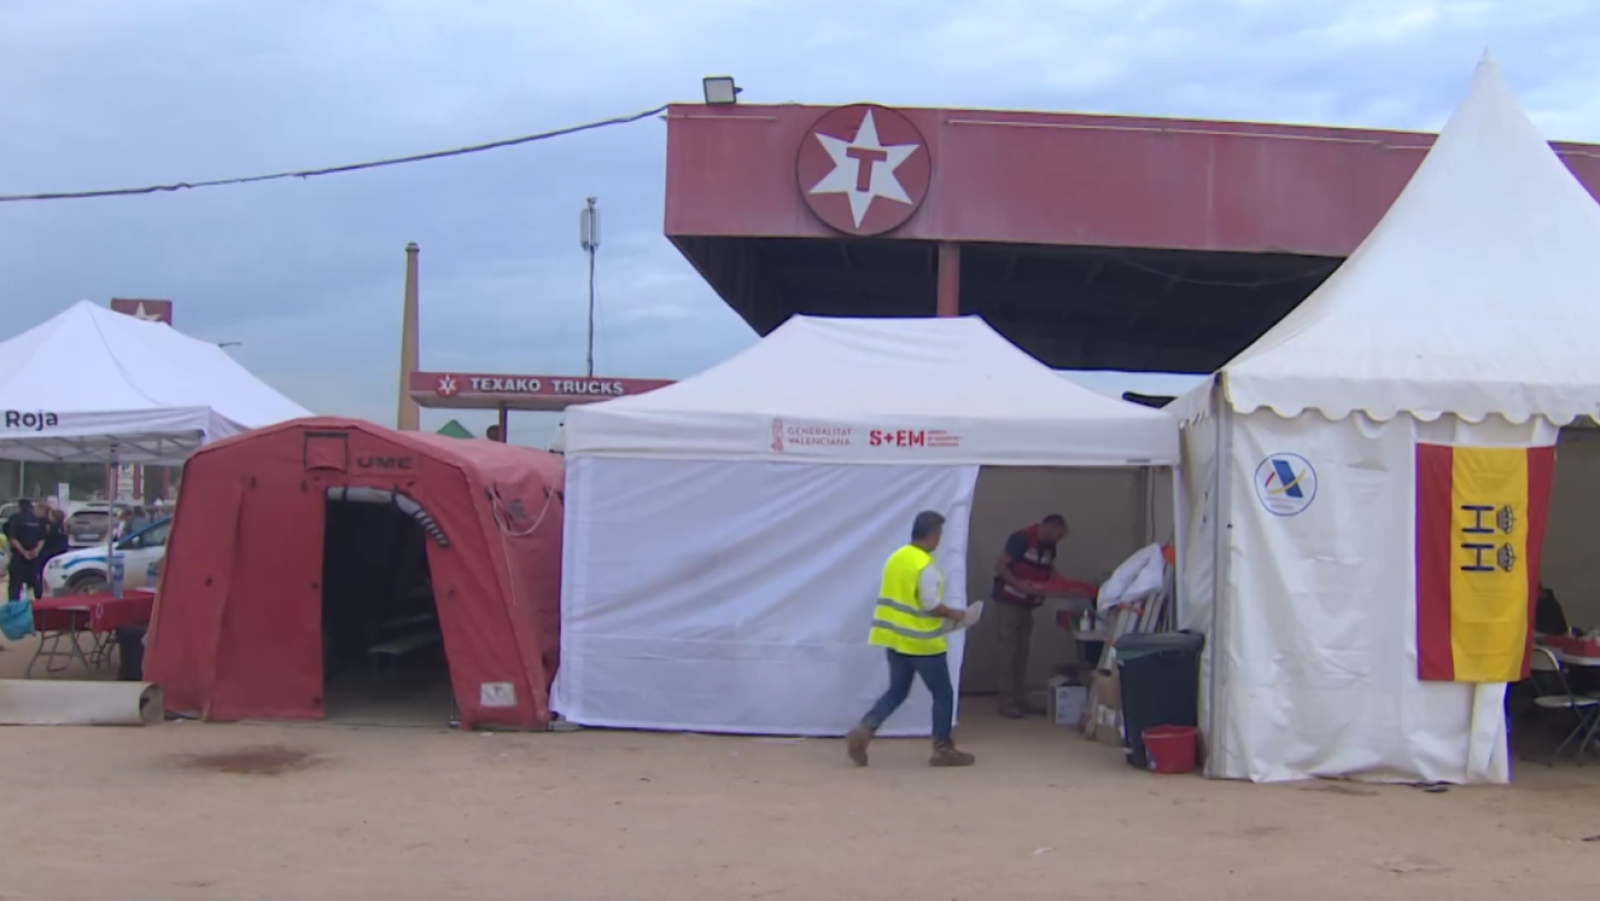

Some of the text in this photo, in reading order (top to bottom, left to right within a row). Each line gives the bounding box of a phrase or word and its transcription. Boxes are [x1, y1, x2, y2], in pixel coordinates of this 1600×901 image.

[846, 146, 888, 192] T
[470, 377, 624, 395] TEXAKO TRUCKS
[5, 409, 58, 431] Roja
[788, 427, 851, 436] GENERALITAT
[869, 429, 924, 447] S+EM
[788, 437, 850, 445] VALENCIANA
[357, 456, 412, 470] UME
